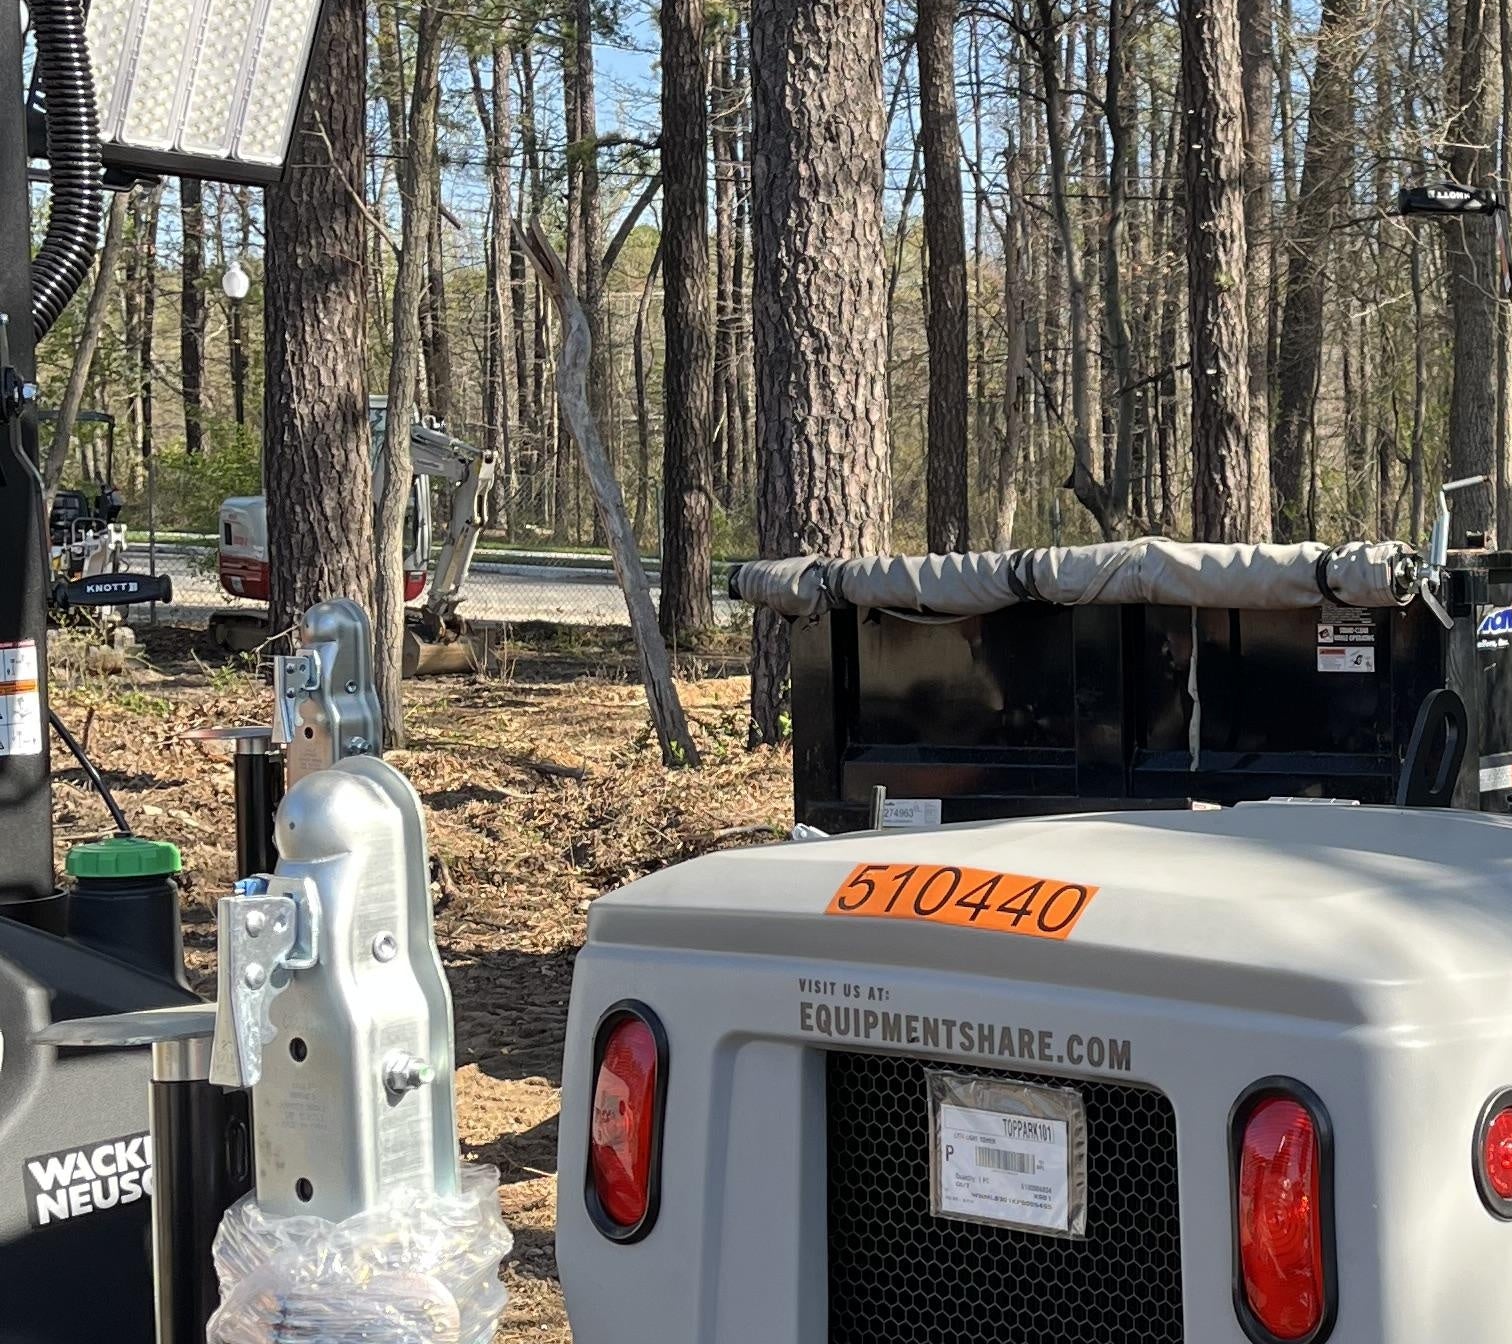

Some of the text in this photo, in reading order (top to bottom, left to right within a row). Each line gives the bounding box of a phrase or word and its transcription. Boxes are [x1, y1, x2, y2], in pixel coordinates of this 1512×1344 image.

[86, 583, 128, 593] KNOTT
[838, 865, 1088, 933] 510440
[799, 978, 890, 1002] VISIT US AT:
[800, 1001, 1132, 1072] EQUIPMENTSHARE.COM
[945, 1144, 954, 1162] P
